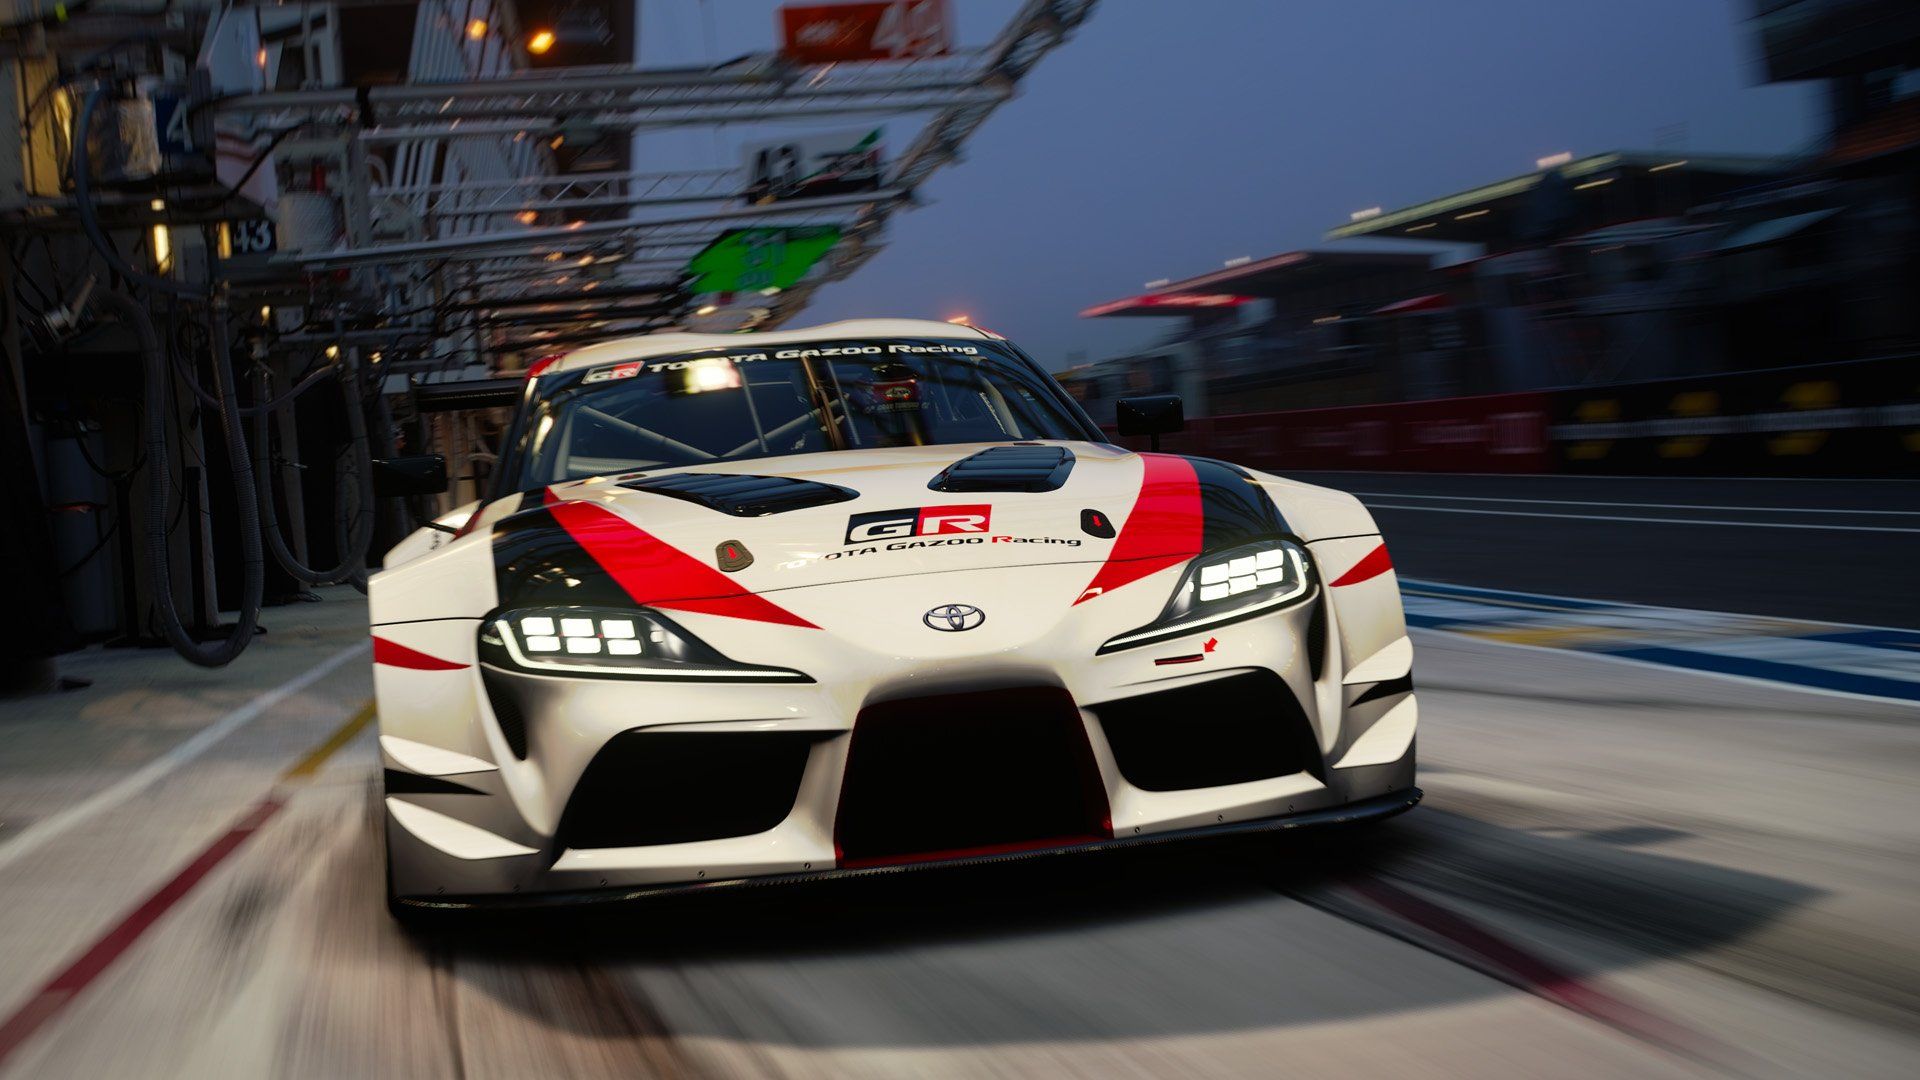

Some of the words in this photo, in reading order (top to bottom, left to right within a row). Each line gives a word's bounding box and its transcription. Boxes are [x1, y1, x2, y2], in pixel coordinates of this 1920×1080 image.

[584, 364, 643, 383] GR
[647, 353, 768, 373] TOTA
[775, 346, 882, 360] GAZOO
[888, 344, 979, 355] Racing
[848, 512, 987, 542] GR
[886, 537, 984, 551] GAZOO
[992, 535, 1082, 547] Racing
